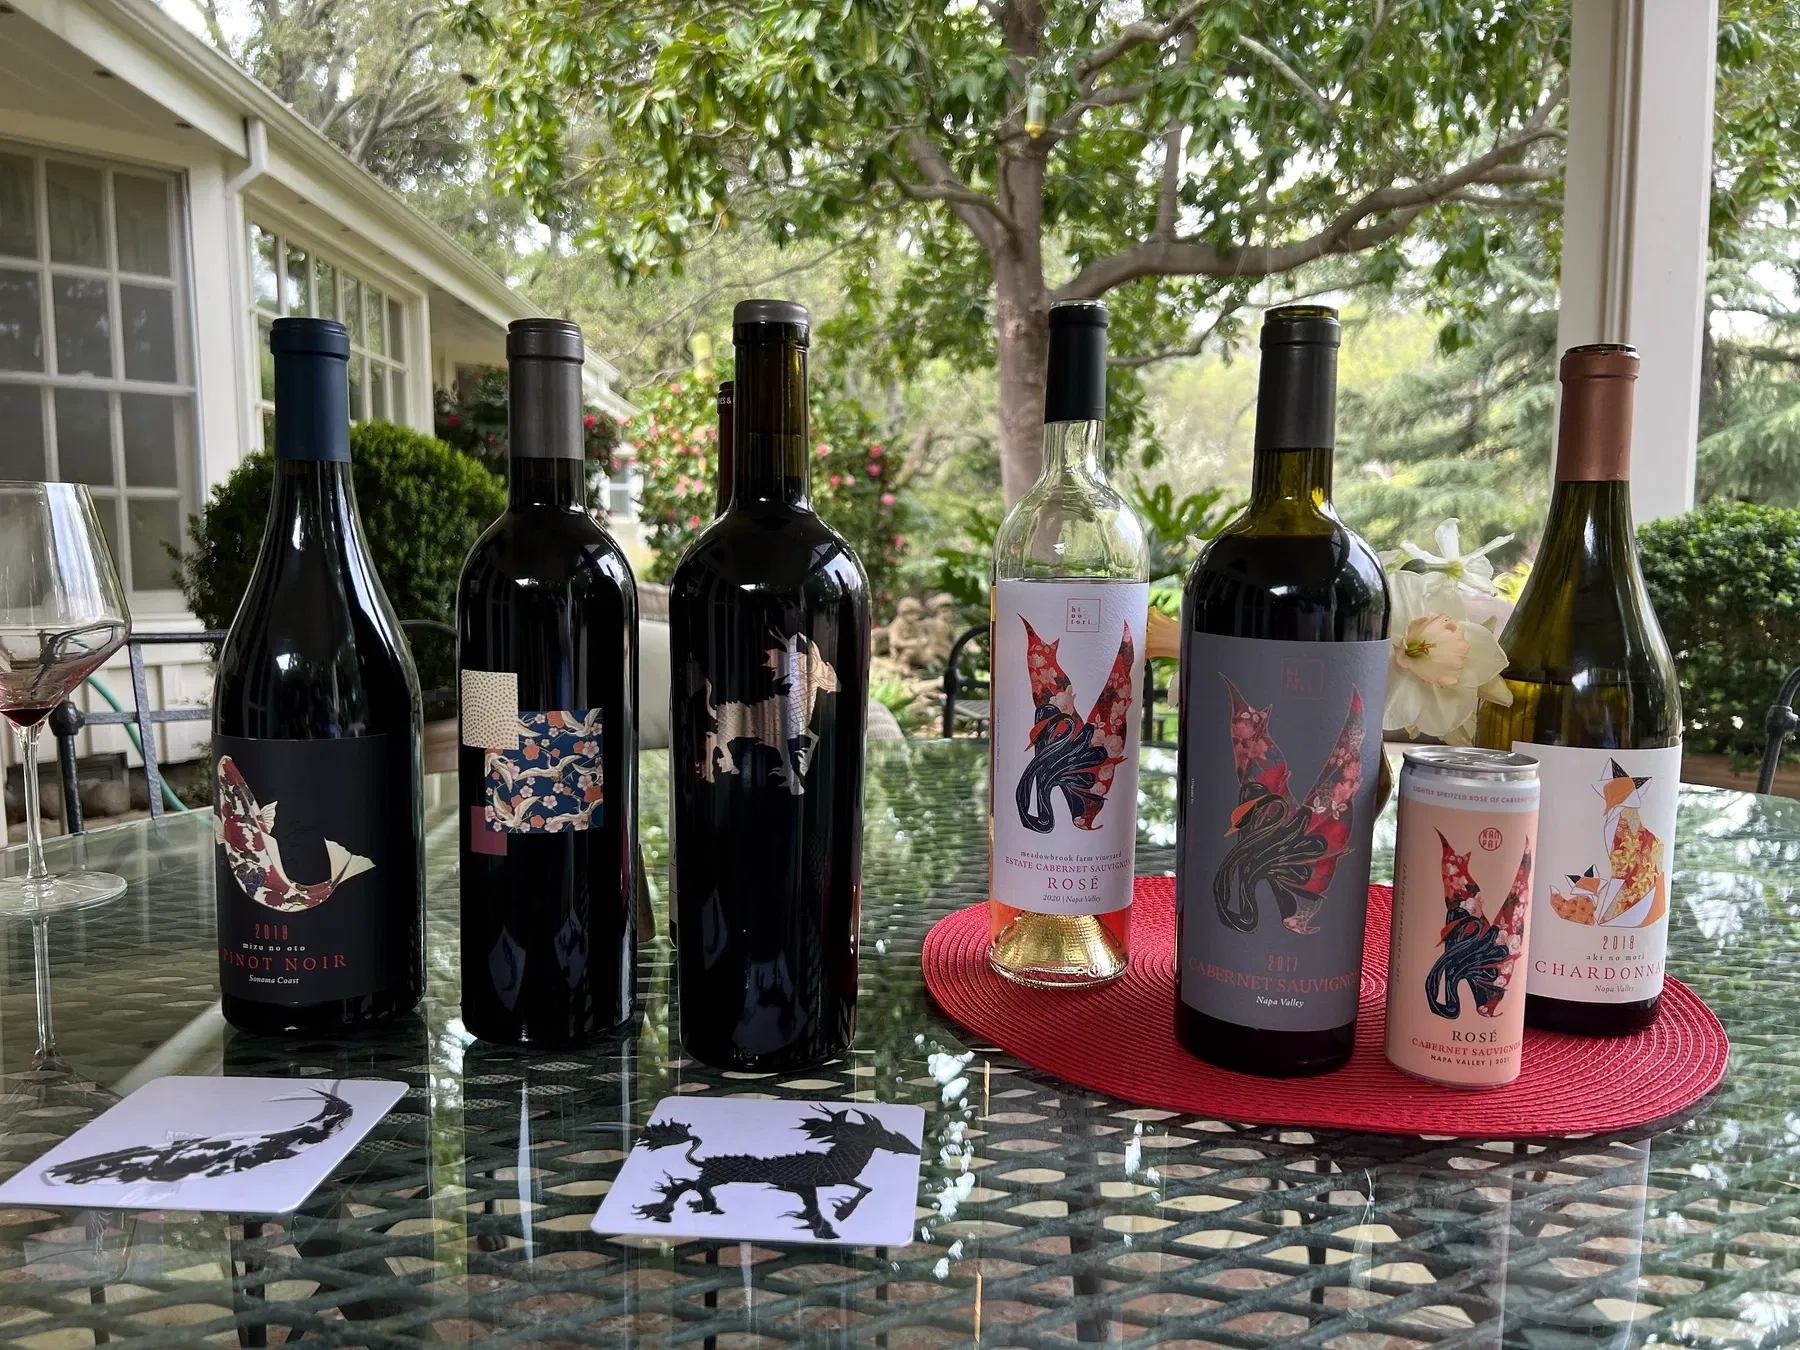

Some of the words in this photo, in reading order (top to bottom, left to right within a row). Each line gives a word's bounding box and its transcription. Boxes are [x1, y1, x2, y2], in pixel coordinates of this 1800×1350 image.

[1020, 850, 1074, 862] meadowbrook
[1075, 854, 1094, 862] farm
[1095, 850, 1123, 862] vineyard
[1005, 855, 1034, 870] ESTATE
[1035, 862, 1089, 874] CABERNET
[1047, 875, 1100, 891] ROSÉ
[1042, 893, 1061, 902] 2020
[1065, 895, 1084, 904] Napa
[1084, 894, 1103, 904] Valley
[254, 923, 289, 941] 2018
[242, 942, 264, 951] mizu
[1602, 935, 1636, 950] 2018
[222, 948, 273, 971] PINOT
[284, 953, 347, 971] NOIR
[1267, 954, 1300, 972] 2017
[1586, 953, 1604, 961] aki
[1625, 952, 1646, 961] mori
[248, 973, 276, 985] Sonoma
[276, 976, 300, 985] Coast
[1188, 955, 1273, 991] CABERNET
[1594, 984, 1615, 993] Napa
[1616, 984, 1636, 993] Valley
[1255, 995, 1279, 1006] Napa
[1280, 997, 1305, 1009] Valley
[1451, 1029, 1498, 1043] ROSÉ
[1411, 1037, 1469, 1056] CABERNET
[1430, 1054, 1453, 1064] NAPA
[1455, 1058, 1486, 1066] VALLEY
